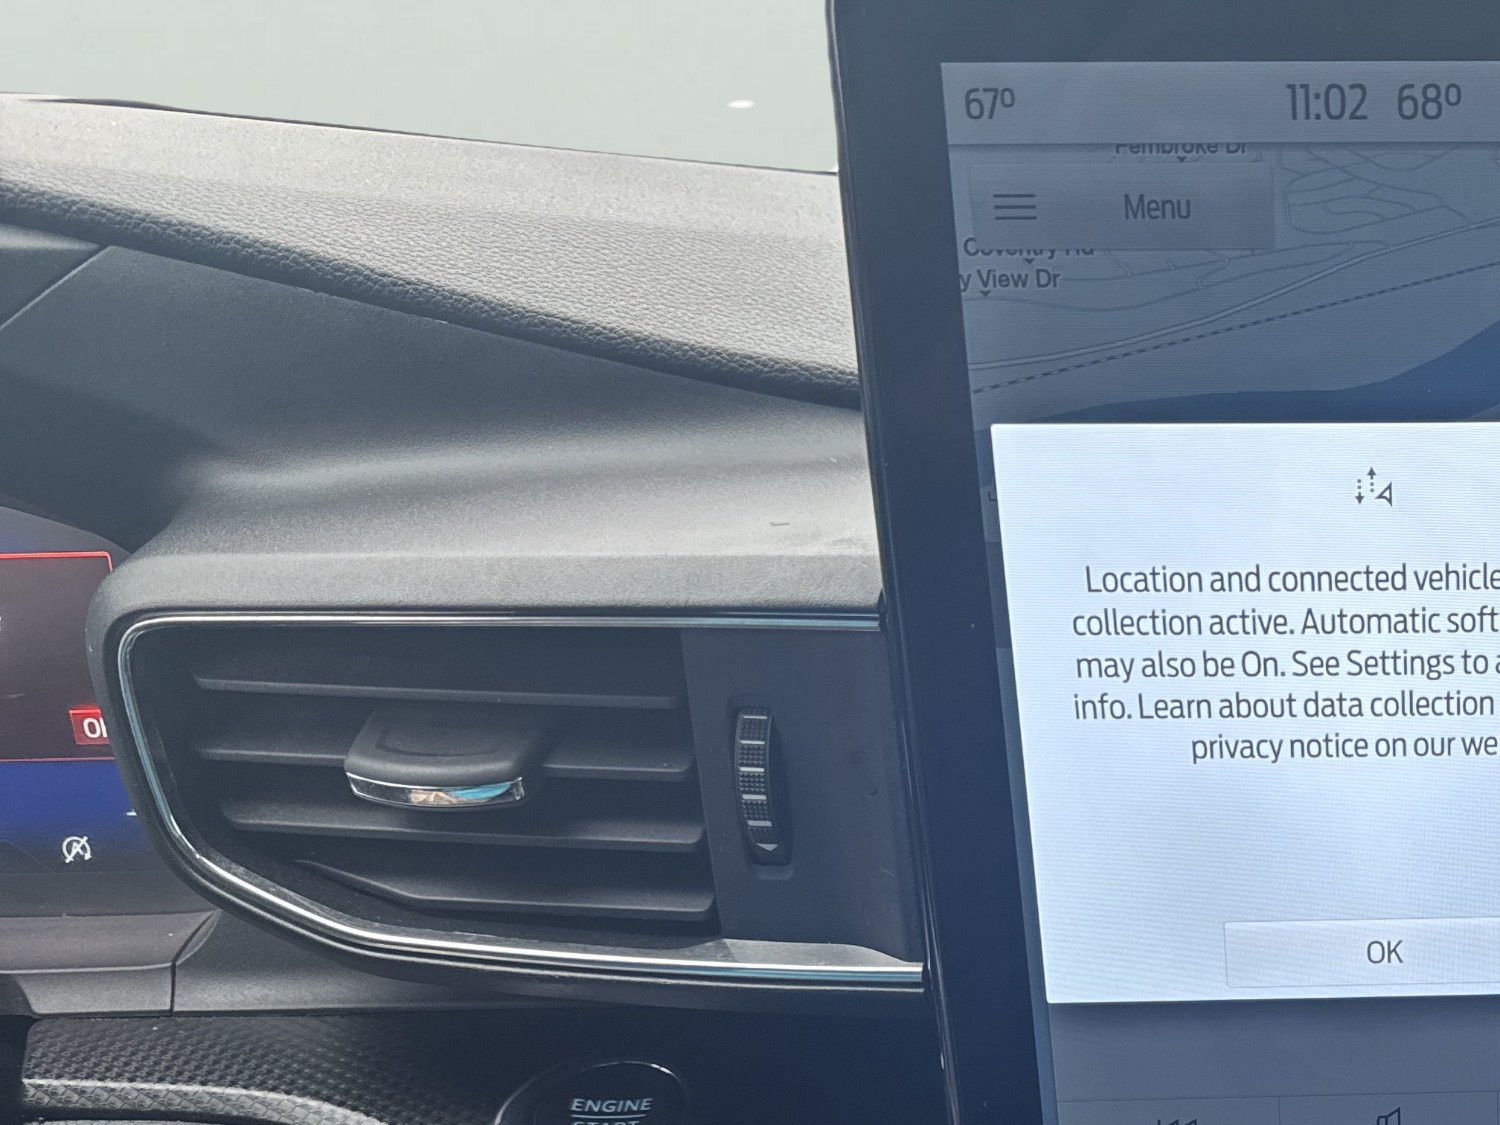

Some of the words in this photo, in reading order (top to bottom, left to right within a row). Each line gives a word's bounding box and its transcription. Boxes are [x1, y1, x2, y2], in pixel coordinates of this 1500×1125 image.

[1285, 83, 1369, 121] 11:02
[1123, 193, 1191, 220] Menu
[976, 269, 1029, 288] View
[1036, 269, 1061, 288] Dr
[1085, 565, 1203, 593] Location
[1209, 564, 1261, 593] and
[1268, 562, 1407, 592] connected
[1072, 607, 1202, 636] collection
[1209, 608, 1295, 635] active.
[1300, 607, 1441, 635] Automatic
[1076, 657, 1135, 684] may
[1141, 650, 1196, 678] also
[1203, 650, 1236, 677] be
[1241, 650, 1287, 677] On.
[1292, 650, 1340, 677] See
[1346, 649, 1455, 681] Settings
[1461, 649, 1489, 675] to
[1074, 693, 1133, 720] info.
[1138, 693, 1212, 719] Learn
[1219, 691, 1298, 719] about
[1303, 691, 1364, 718] data
[1370, 690, 1495, 717] collection
[1191, 734, 1284, 765] privacy
[1290, 733, 1369, 758] notice
[1375, 737, 1407, 757] on
[1413, 737, 1456, 757] our
[1365, 939, 1404, 966] OK
[569, 1098, 653, 1113] ENGINE
